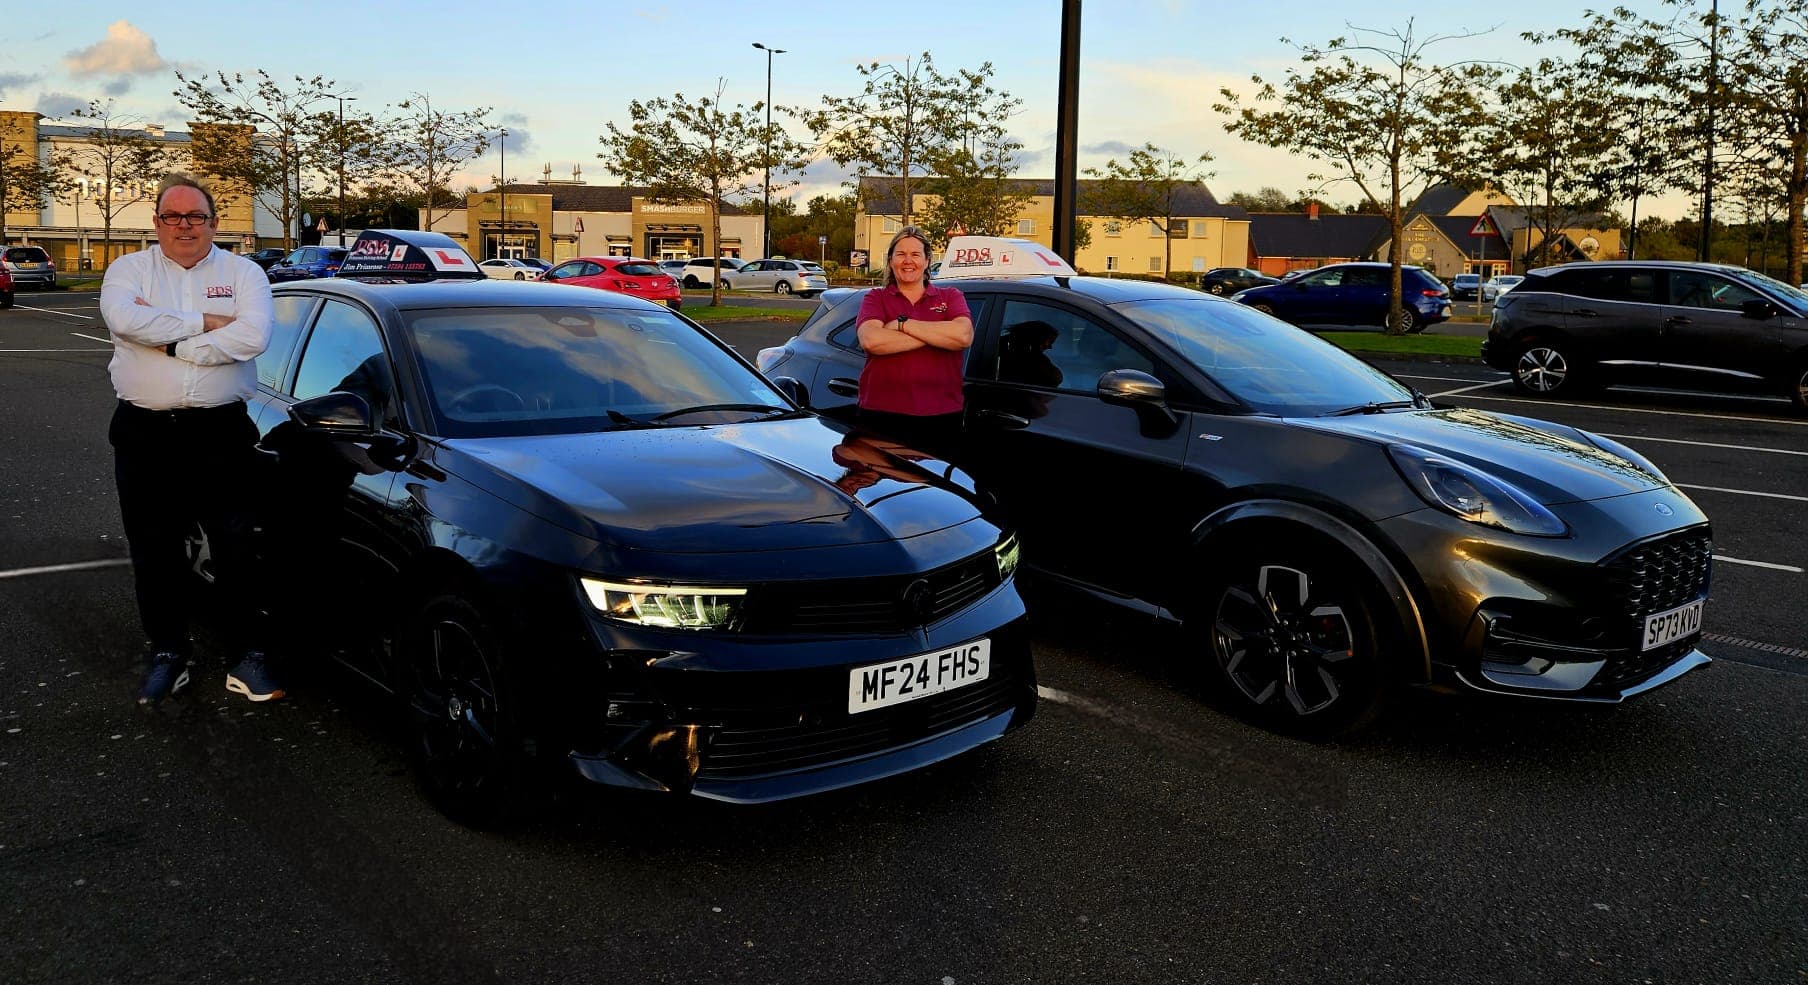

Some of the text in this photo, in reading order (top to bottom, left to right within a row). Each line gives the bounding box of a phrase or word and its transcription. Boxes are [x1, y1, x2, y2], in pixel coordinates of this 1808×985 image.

[434, 250, 464, 265] L
[955, 247, 992, 262] PDS
[1033, 251, 1062, 266] L
[207, 286, 233, 295] PDS
[1648, 612, 1679, 645] SP73
[862, 645, 980, 703] MF24 FHS
